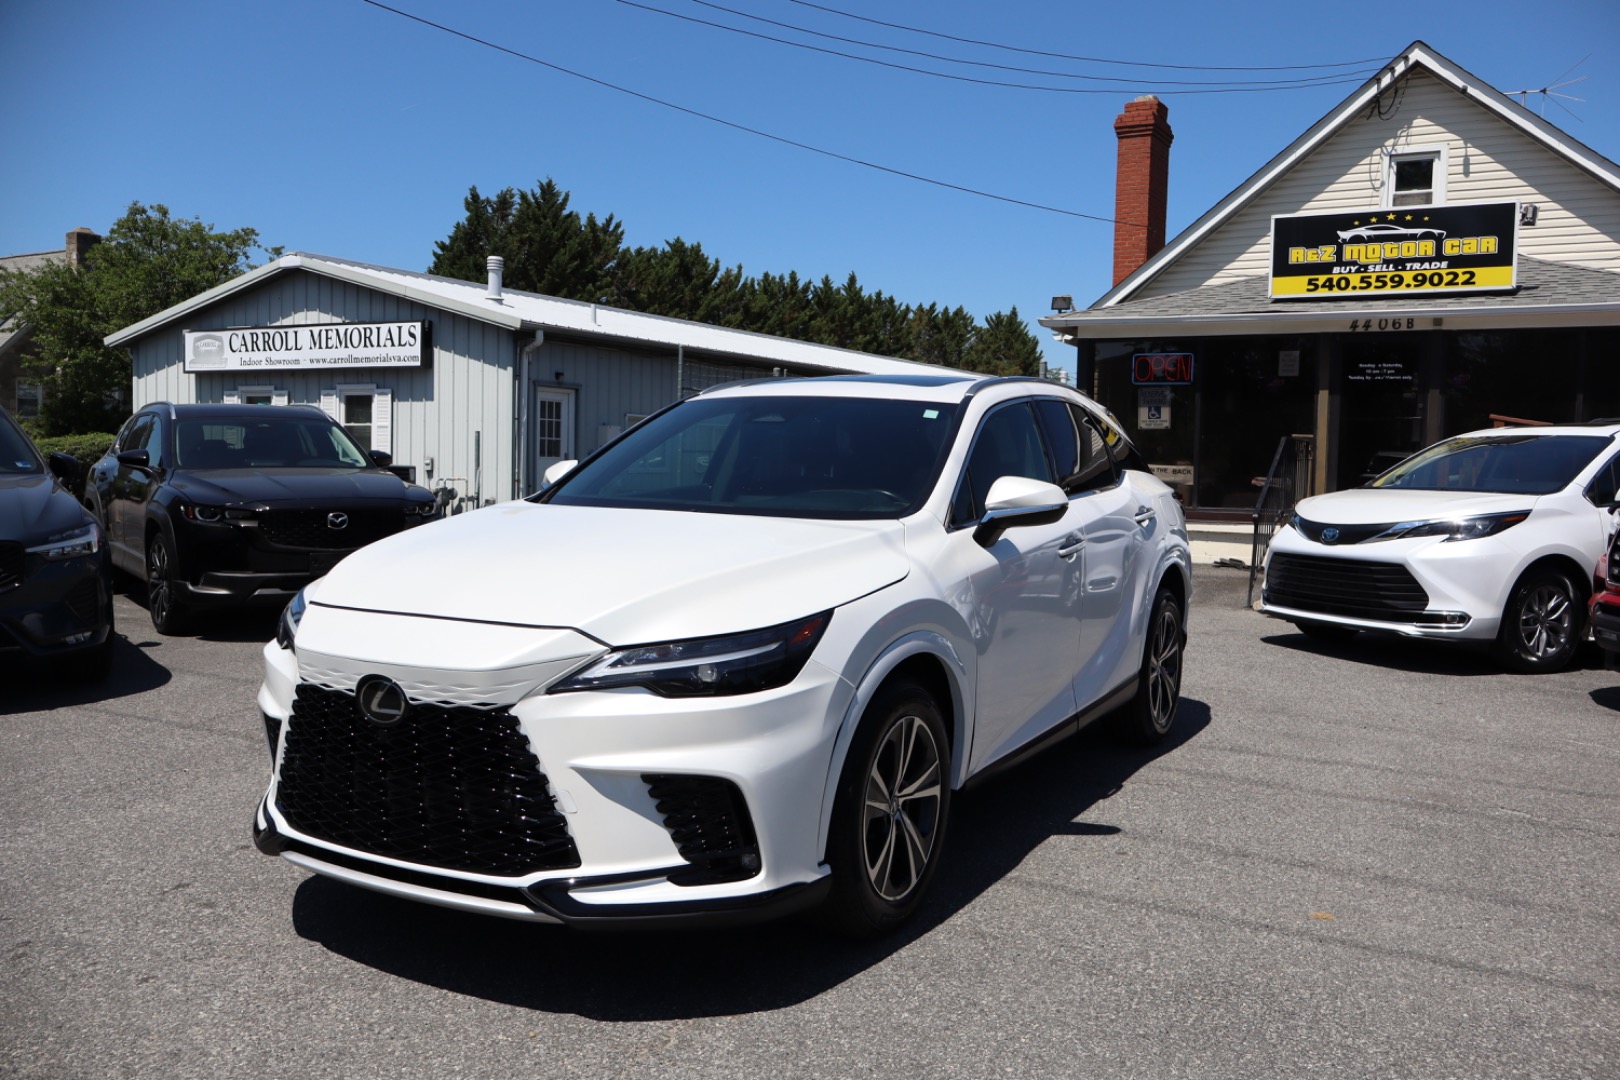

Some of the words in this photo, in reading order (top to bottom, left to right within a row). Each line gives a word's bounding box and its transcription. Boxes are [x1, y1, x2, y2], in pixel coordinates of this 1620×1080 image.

[1289, 245, 1336, 264] R&Z
[1332, 265, 1359, 274] BUY
[1367, 263, 1395, 272] SELL
[1404, 261, 1448, 270] TRADE
[1306, 271, 1476, 292] 540.559.9022
[228, 330, 303, 353] CARROLL
[309, 325, 417, 350] MEMORIALS
[240, 357, 263, 366] Indoor
[264, 356, 301, 366] Showroom
[309, 353, 420, 364] www.carrollmemorialsva.com
[1135, 356, 1191, 381] OPEN
